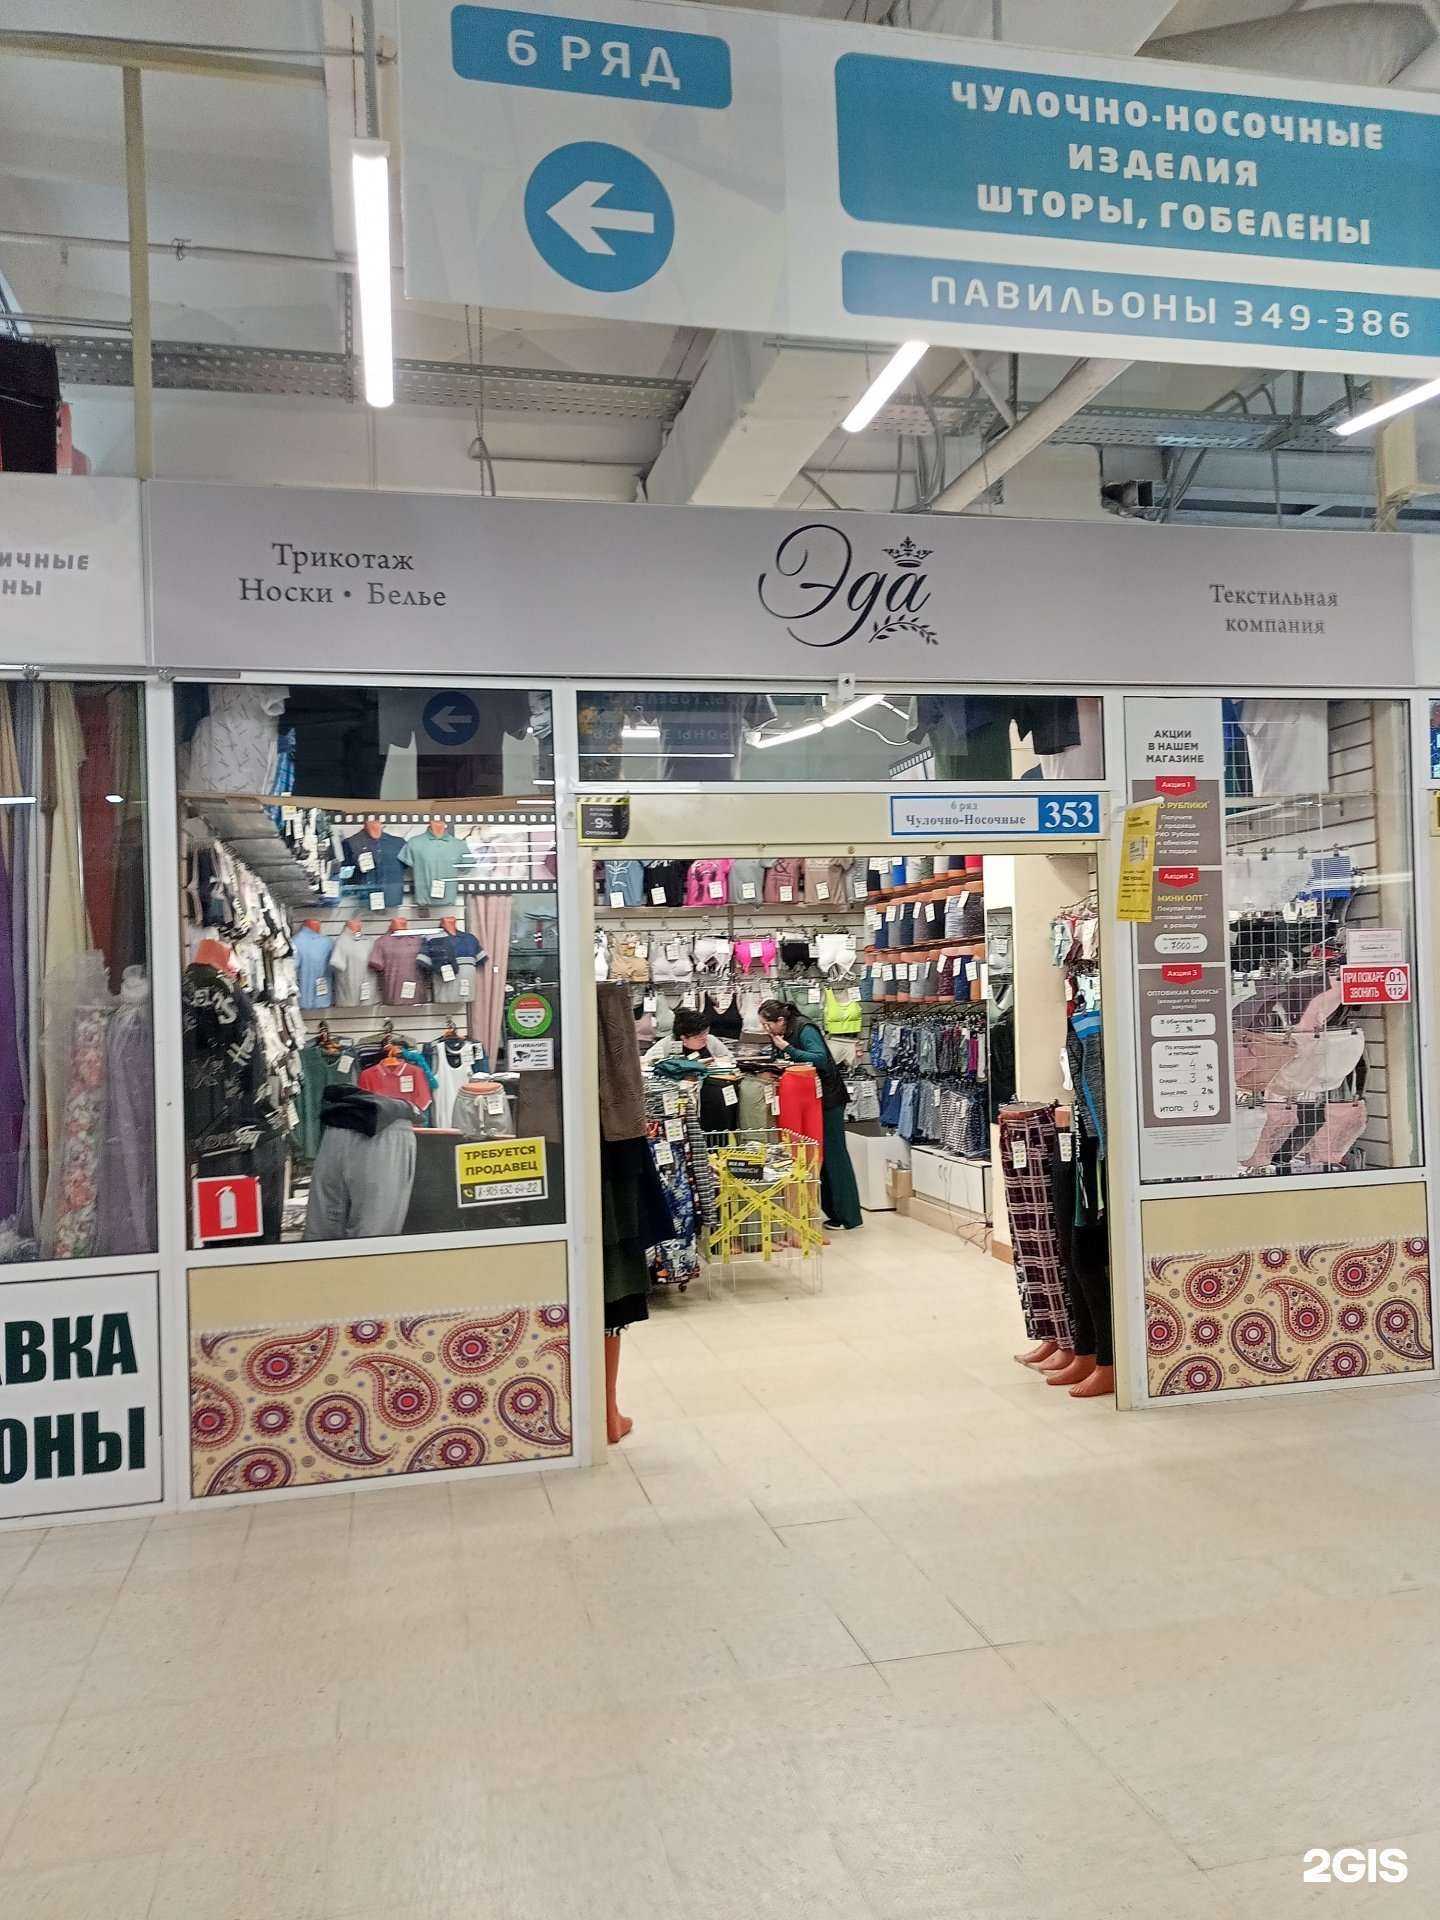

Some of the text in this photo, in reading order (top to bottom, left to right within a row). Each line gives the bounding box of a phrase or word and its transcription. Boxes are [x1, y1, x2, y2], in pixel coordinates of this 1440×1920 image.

[507, 28, 681, 90] 6 РЯД
[950, 80, 1384, 151] ЧУЛОЧНО-НОСОЧНЫЕ
[1068, 142, 1259, 187] ИЗДЕЛИЯ
[976, 183, 1372, 246] ШТОРЫ, ГОБЕЛЕНЫ
[930, 275, 1411, 339] ПАВИЛЬОНЫ 349-386
[272, 543, 414, 574] Трикотаж
[238, 577, 447, 607] Носки Белье
[757, 523, 932, 647] Эда
[1208, 584, 1338, 607] Текстильная
[1224, 618, 1326, 634] компания
[1153, 729, 1193, 739] АКЦИИ
[1147, 742, 1199, 751] В НАШЕМ
[1145, 754, 1205, 763] МАГАЗИНЕ
[905, 814, 1027, 829] Чулочно-Носочные
[1043, 801, 1095, 828] 353
[1164, 872, 1188, 880] Акция
[1166, 970, 1193, 978] Акция
[1388, 971, 1403, 983] 01
[1387, 986, 1404, 997] 112
[463, 1145, 537, 1161] ТРЕБУЕТСЯ
[465, 1160, 538, 1176] ПРОДАВЕЦ
[0, 1312, 138, 1386] ВКА
